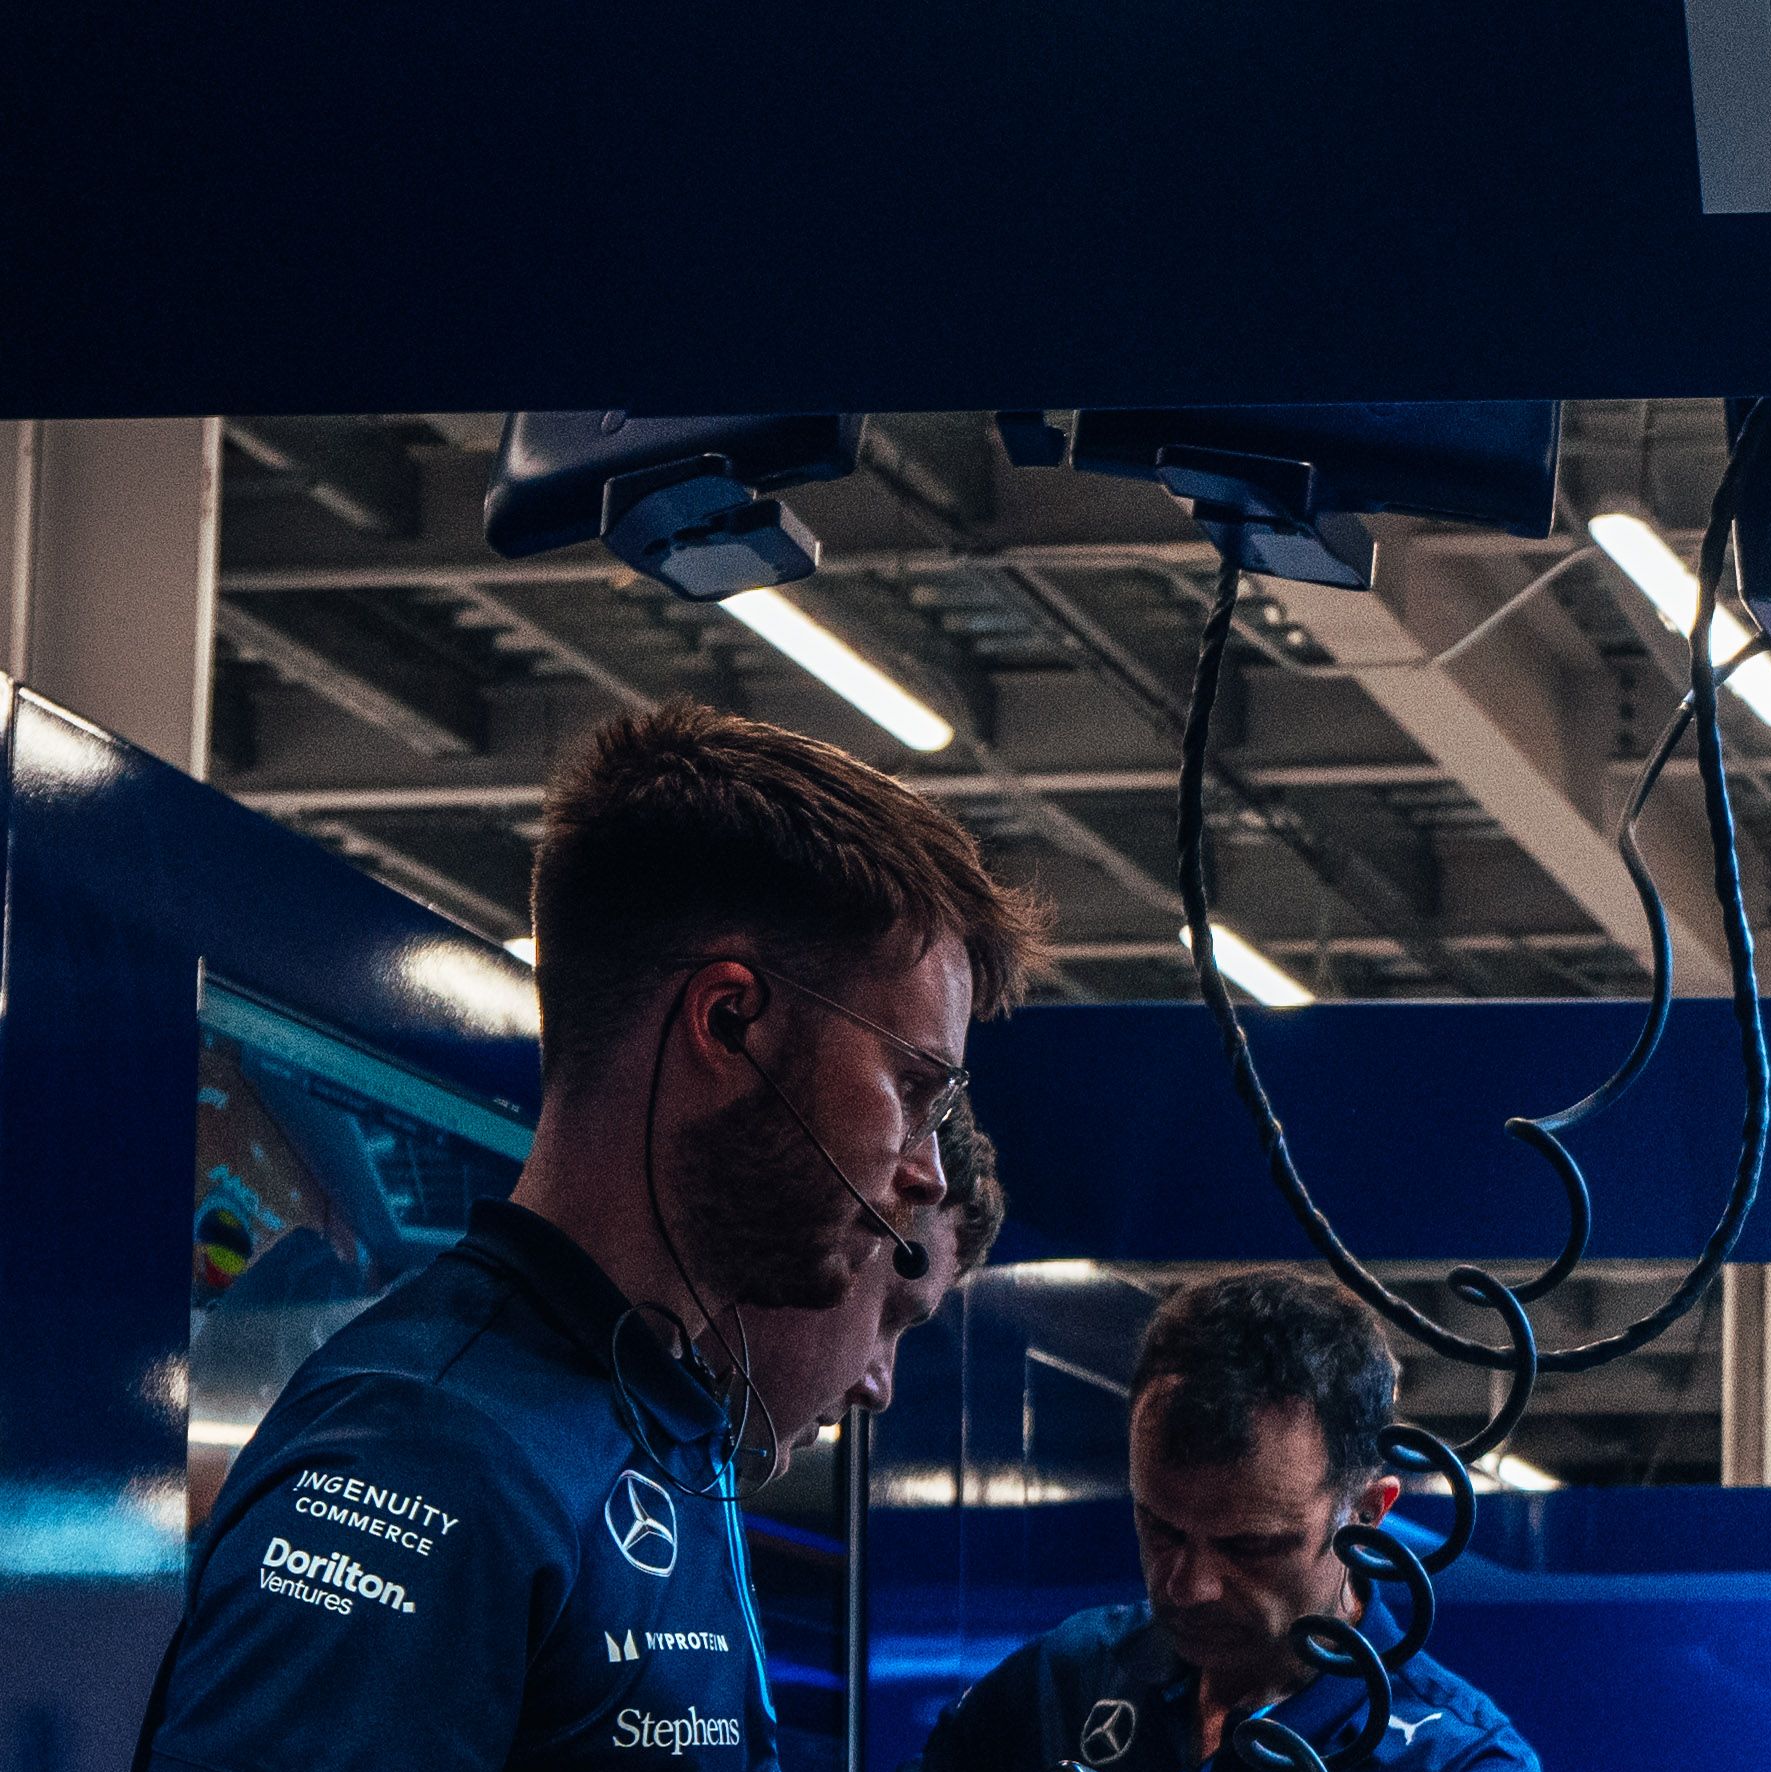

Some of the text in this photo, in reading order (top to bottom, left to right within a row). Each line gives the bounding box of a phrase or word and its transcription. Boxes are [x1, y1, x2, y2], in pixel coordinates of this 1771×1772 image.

[292, 1469, 460, 1536] INGENUITY
[294, 1496, 435, 1557] COMMERCE
[259, 1567, 354, 1616] Ventures
[612, 1705, 740, 1756] Stephens
